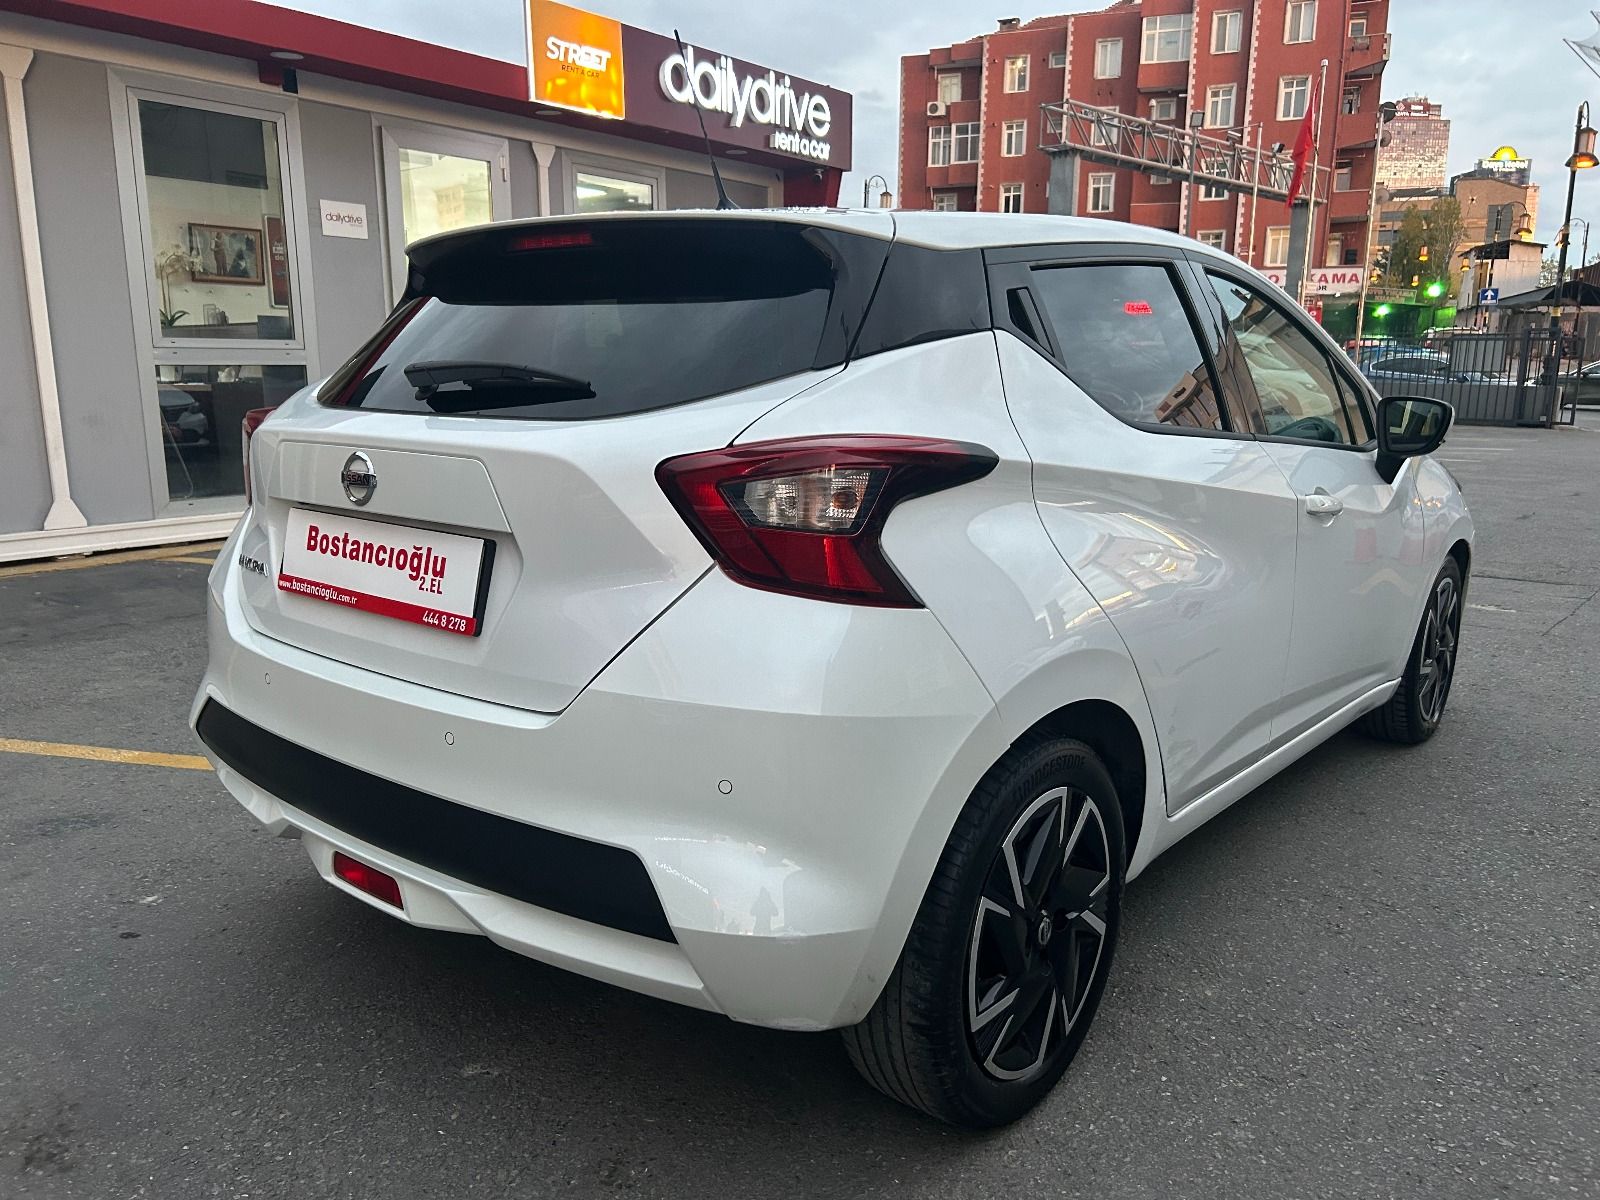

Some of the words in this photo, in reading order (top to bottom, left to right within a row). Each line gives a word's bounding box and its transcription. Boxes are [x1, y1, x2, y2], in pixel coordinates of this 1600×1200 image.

[546, 36, 612, 73] STREET
[561, 64, 579, 76] RENT
[580, 69, 586, 77] A
[586, 70, 600, 79] CAR
[658, 45, 832, 138] dailydrive
[770, 130, 801, 154] rent
[799, 138, 810, 156] a
[809, 139, 831, 161] car
[325, 211, 363, 225] dailydrive
[306, 524, 447, 581] Bostancıoğlu
[418, 575, 443, 595] 2.EL
[422, 610, 440, 626] 444
[440, 614, 447, 628] 8
[448, 616, 467, 632] 278
